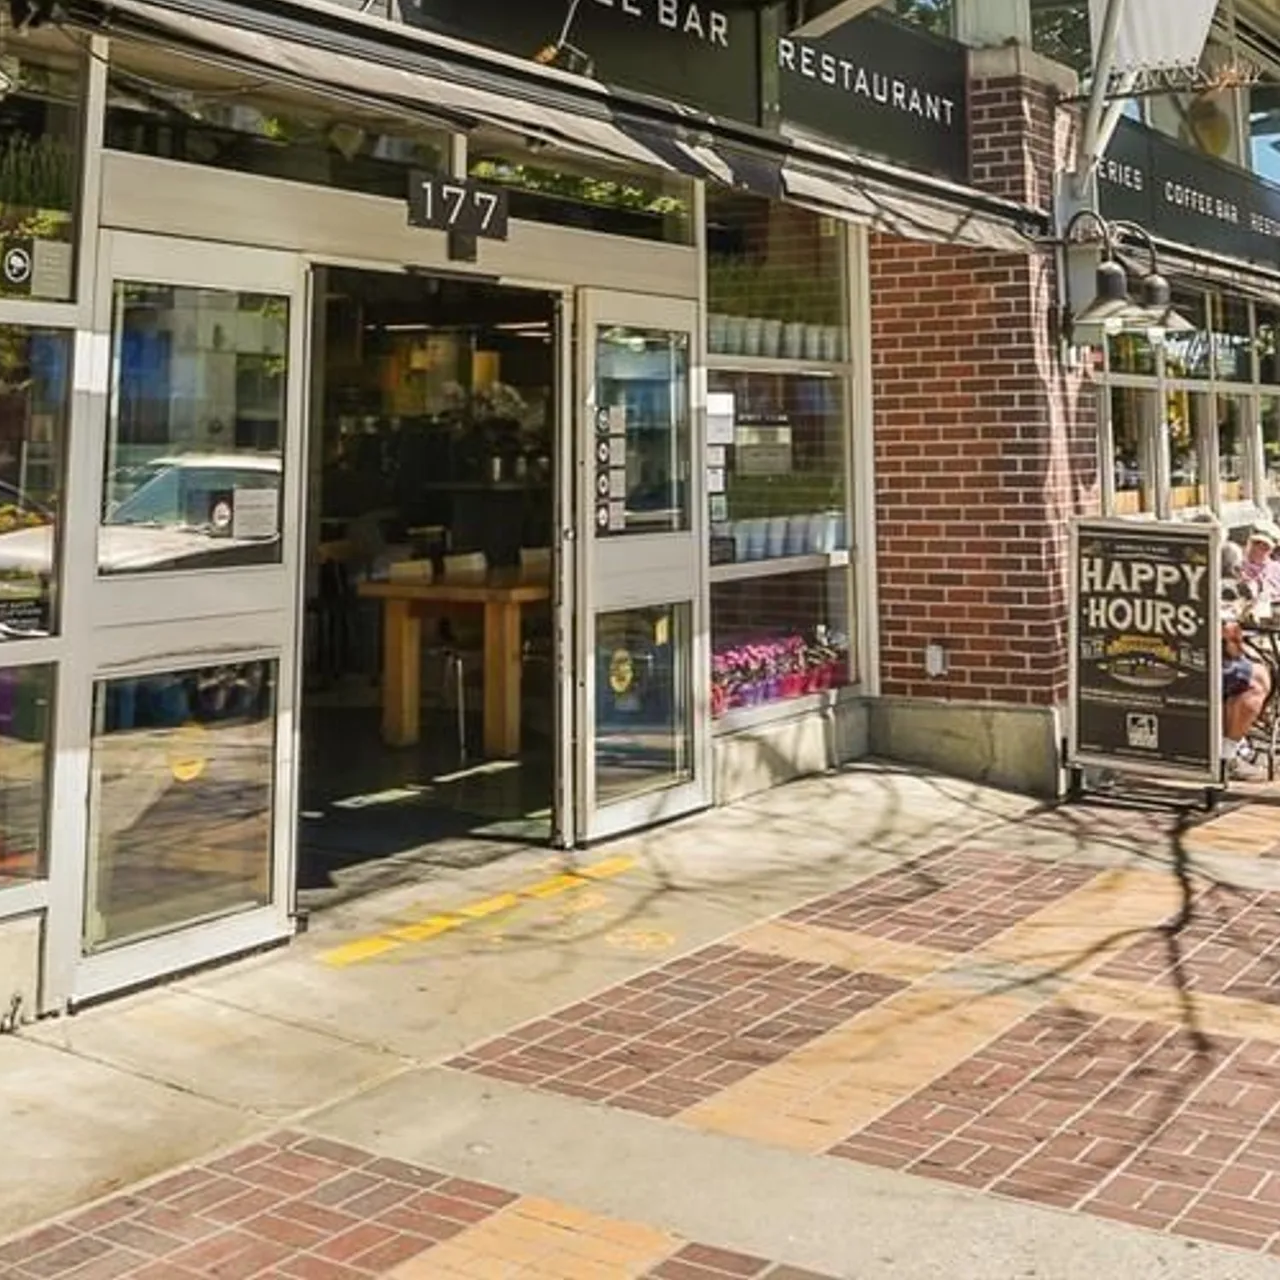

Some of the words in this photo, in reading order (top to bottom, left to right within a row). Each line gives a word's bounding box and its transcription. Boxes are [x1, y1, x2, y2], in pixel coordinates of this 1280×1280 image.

[778, 37, 955, 125] RESTAURANT
[421, 180, 499, 231] 177
[1164, 181, 1214, 216] COFFEE
[1216, 198, 1239, 224] BAR
[1080, 557, 1207, 601] HAPPY
[1087, 597, 1199, 637] HOURS
